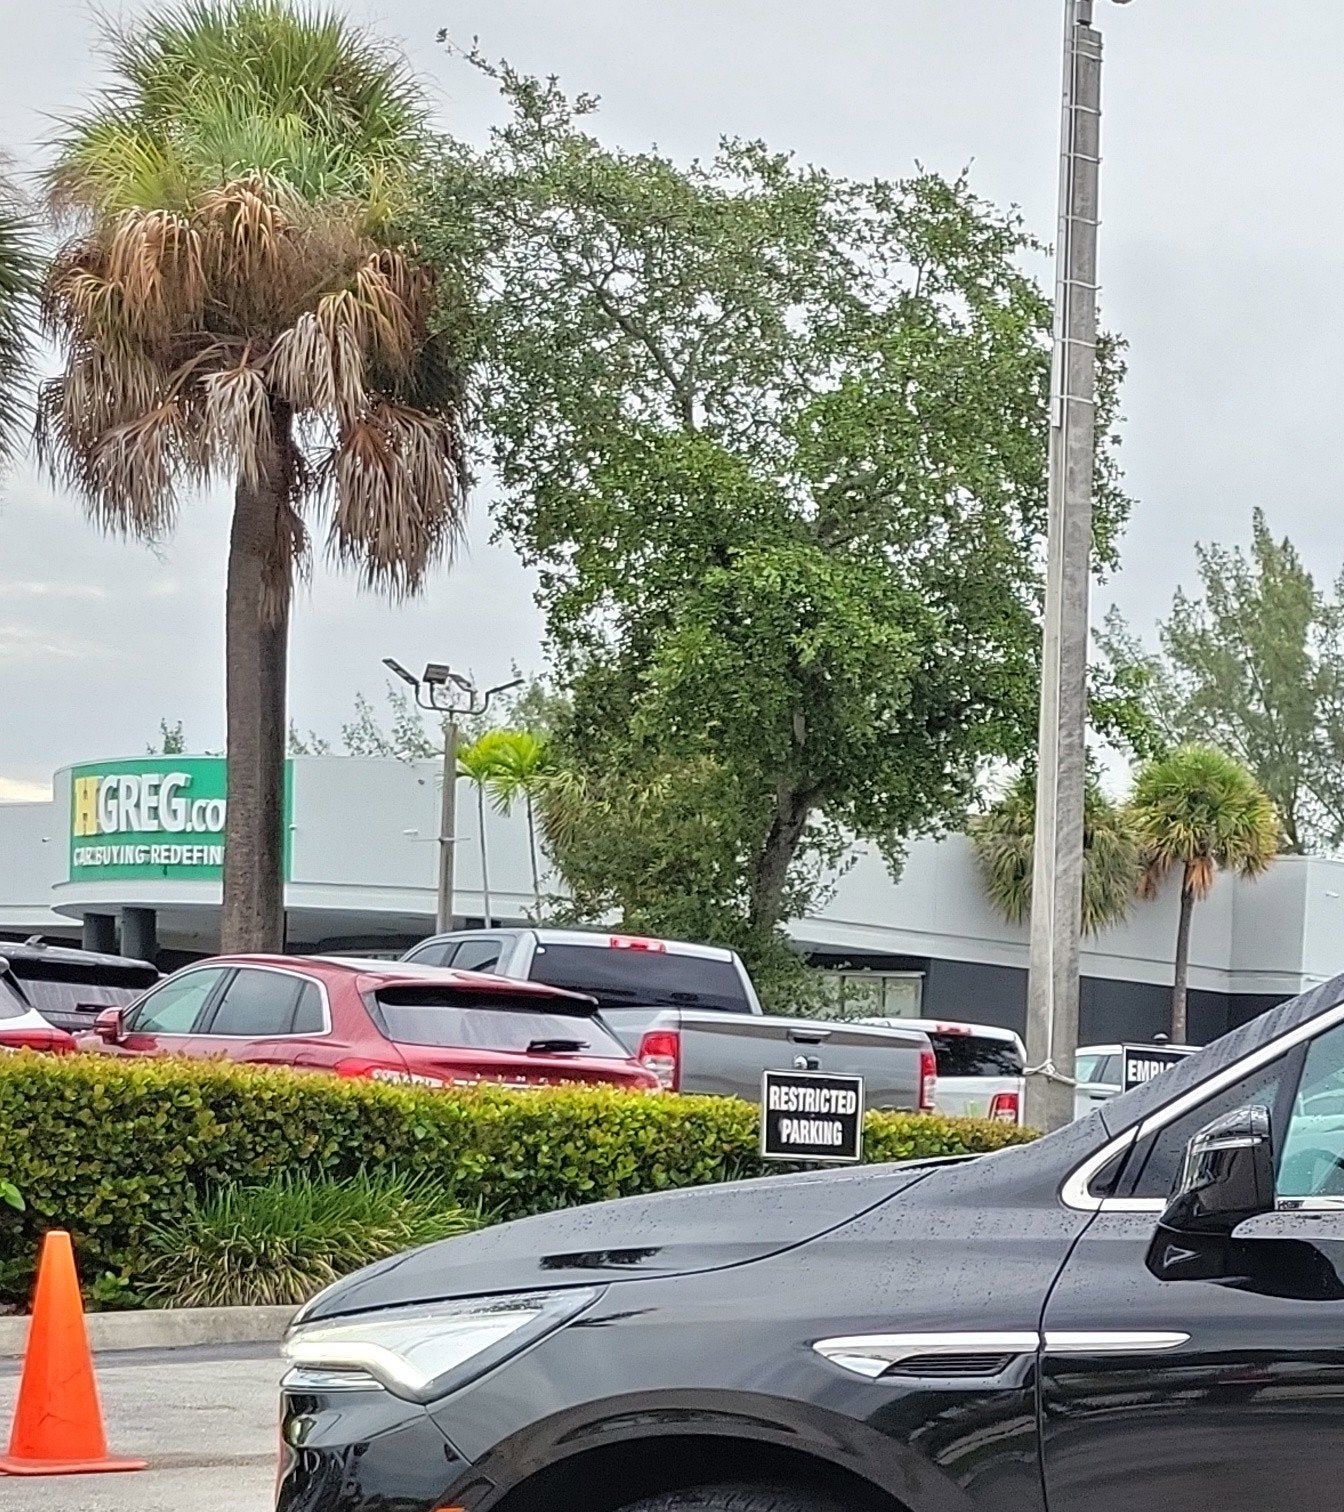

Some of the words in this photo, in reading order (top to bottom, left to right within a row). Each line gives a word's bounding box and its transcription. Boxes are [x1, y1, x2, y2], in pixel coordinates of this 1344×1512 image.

[74, 772, 226, 836] HGREG.co
[96, 845, 148, 865] BUYING
[151, 844, 225, 865] REDEFIN
[769, 1085, 856, 1115] RESTRICTED
[780, 1118, 842, 1146] PARKING
